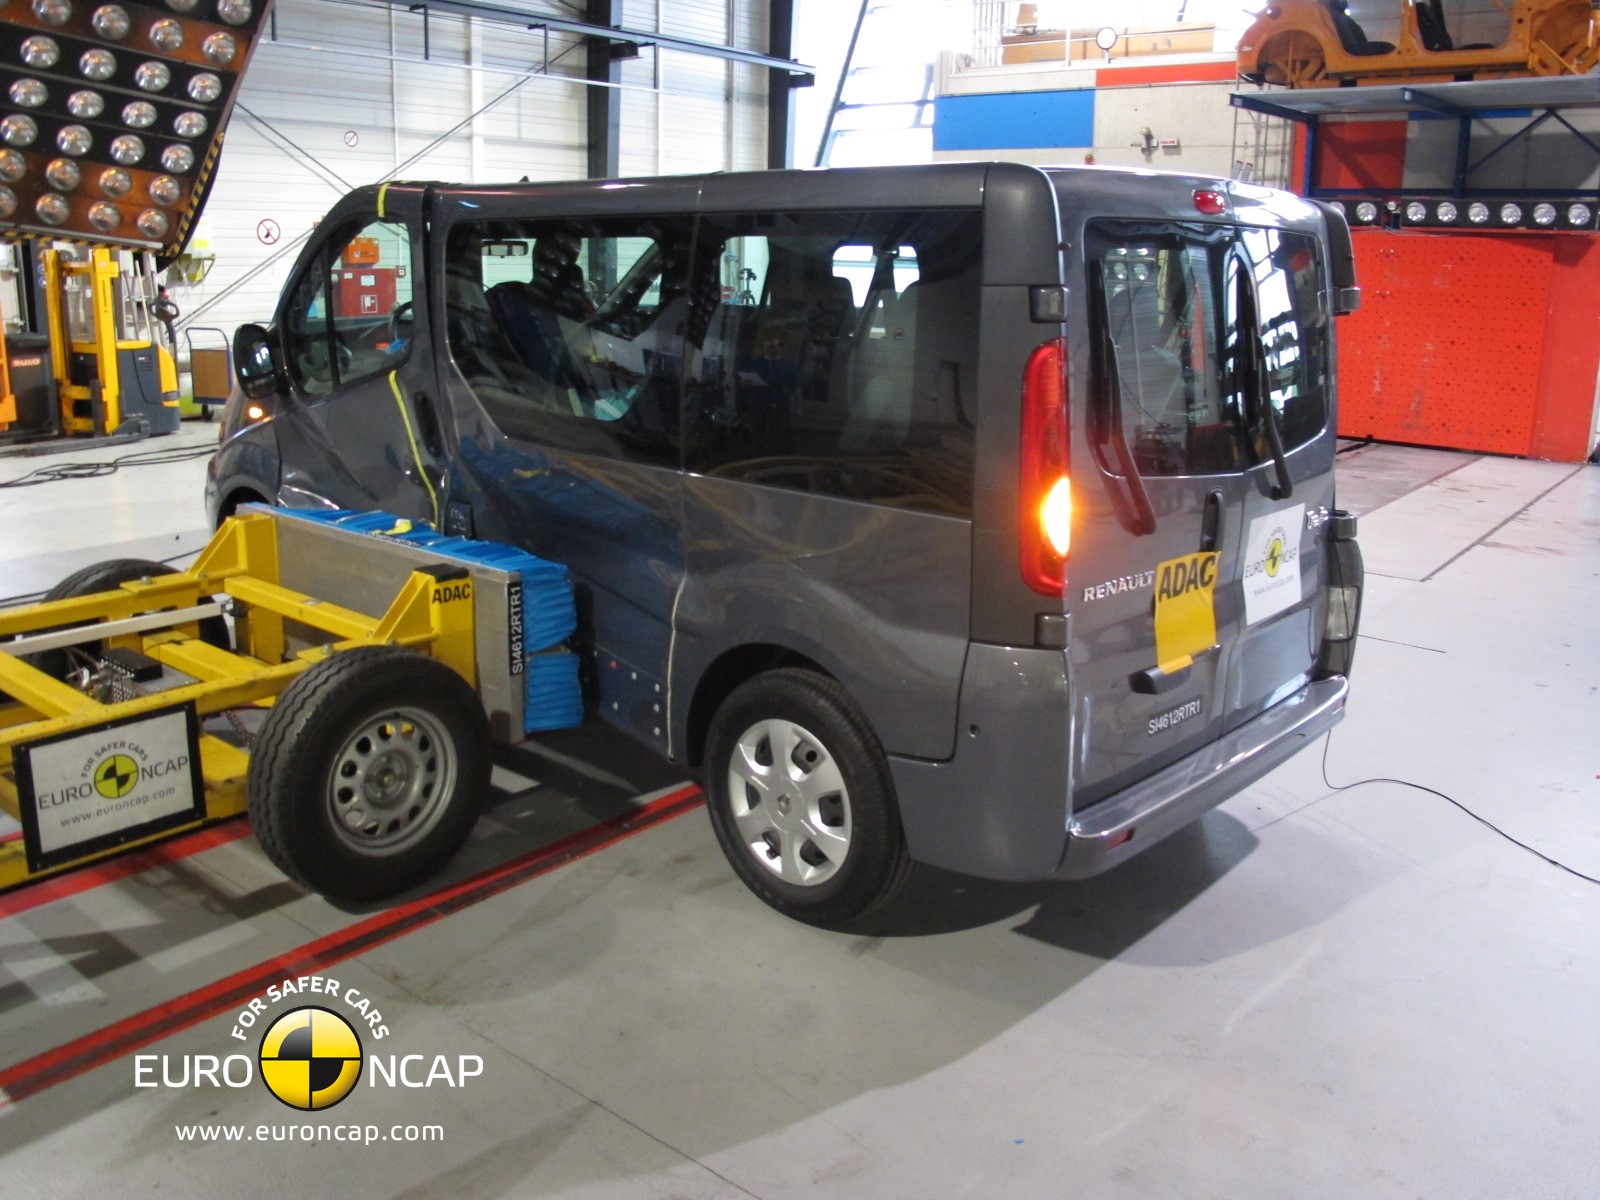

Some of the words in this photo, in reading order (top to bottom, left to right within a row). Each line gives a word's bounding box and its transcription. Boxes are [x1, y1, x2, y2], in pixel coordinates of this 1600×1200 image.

[432, 583, 471, 604] ADAC
[1083, 571, 1155, 602] RENAULT
[1158, 555, 1216, 602] ADAC
[510, 586, 523, 674] SI4612RTR1
[1148, 700, 1200, 734] SI4612RTR1
[81, 757, 95, 778] FOR
[95, 741, 126, 758] SAFER
[128, 742, 149, 761] CARS
[38, 782, 93, 810] EURO
[141, 755, 188, 782] NCAP
[60, 786, 176, 827] www.euroncap.com
